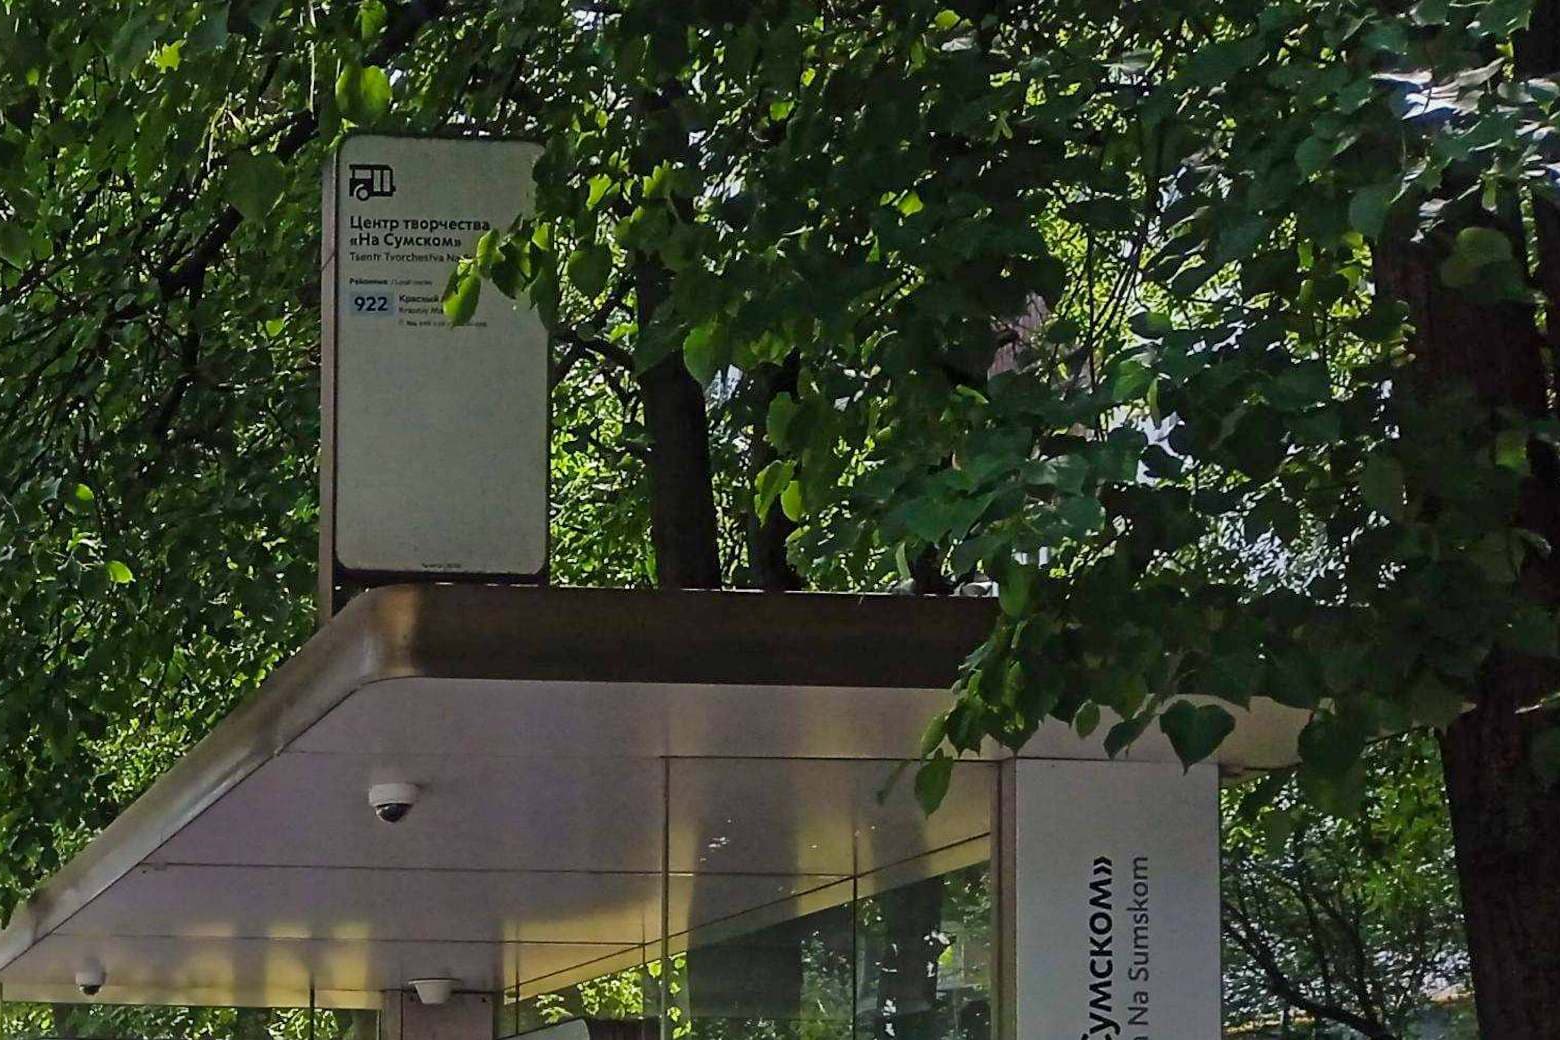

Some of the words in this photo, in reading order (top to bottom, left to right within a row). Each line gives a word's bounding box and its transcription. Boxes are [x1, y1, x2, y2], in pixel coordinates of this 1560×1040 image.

[350, 216, 399, 231] Центр
[403, 219, 490, 232] творчества
[350, 233, 379, 246] «На
[383, 233, 461, 248] Сумском»
[354, 296, 389, 312] 922
[1127, 856, 1149, 981] Sumskom
[1128, 992, 1149, 1024] Na
